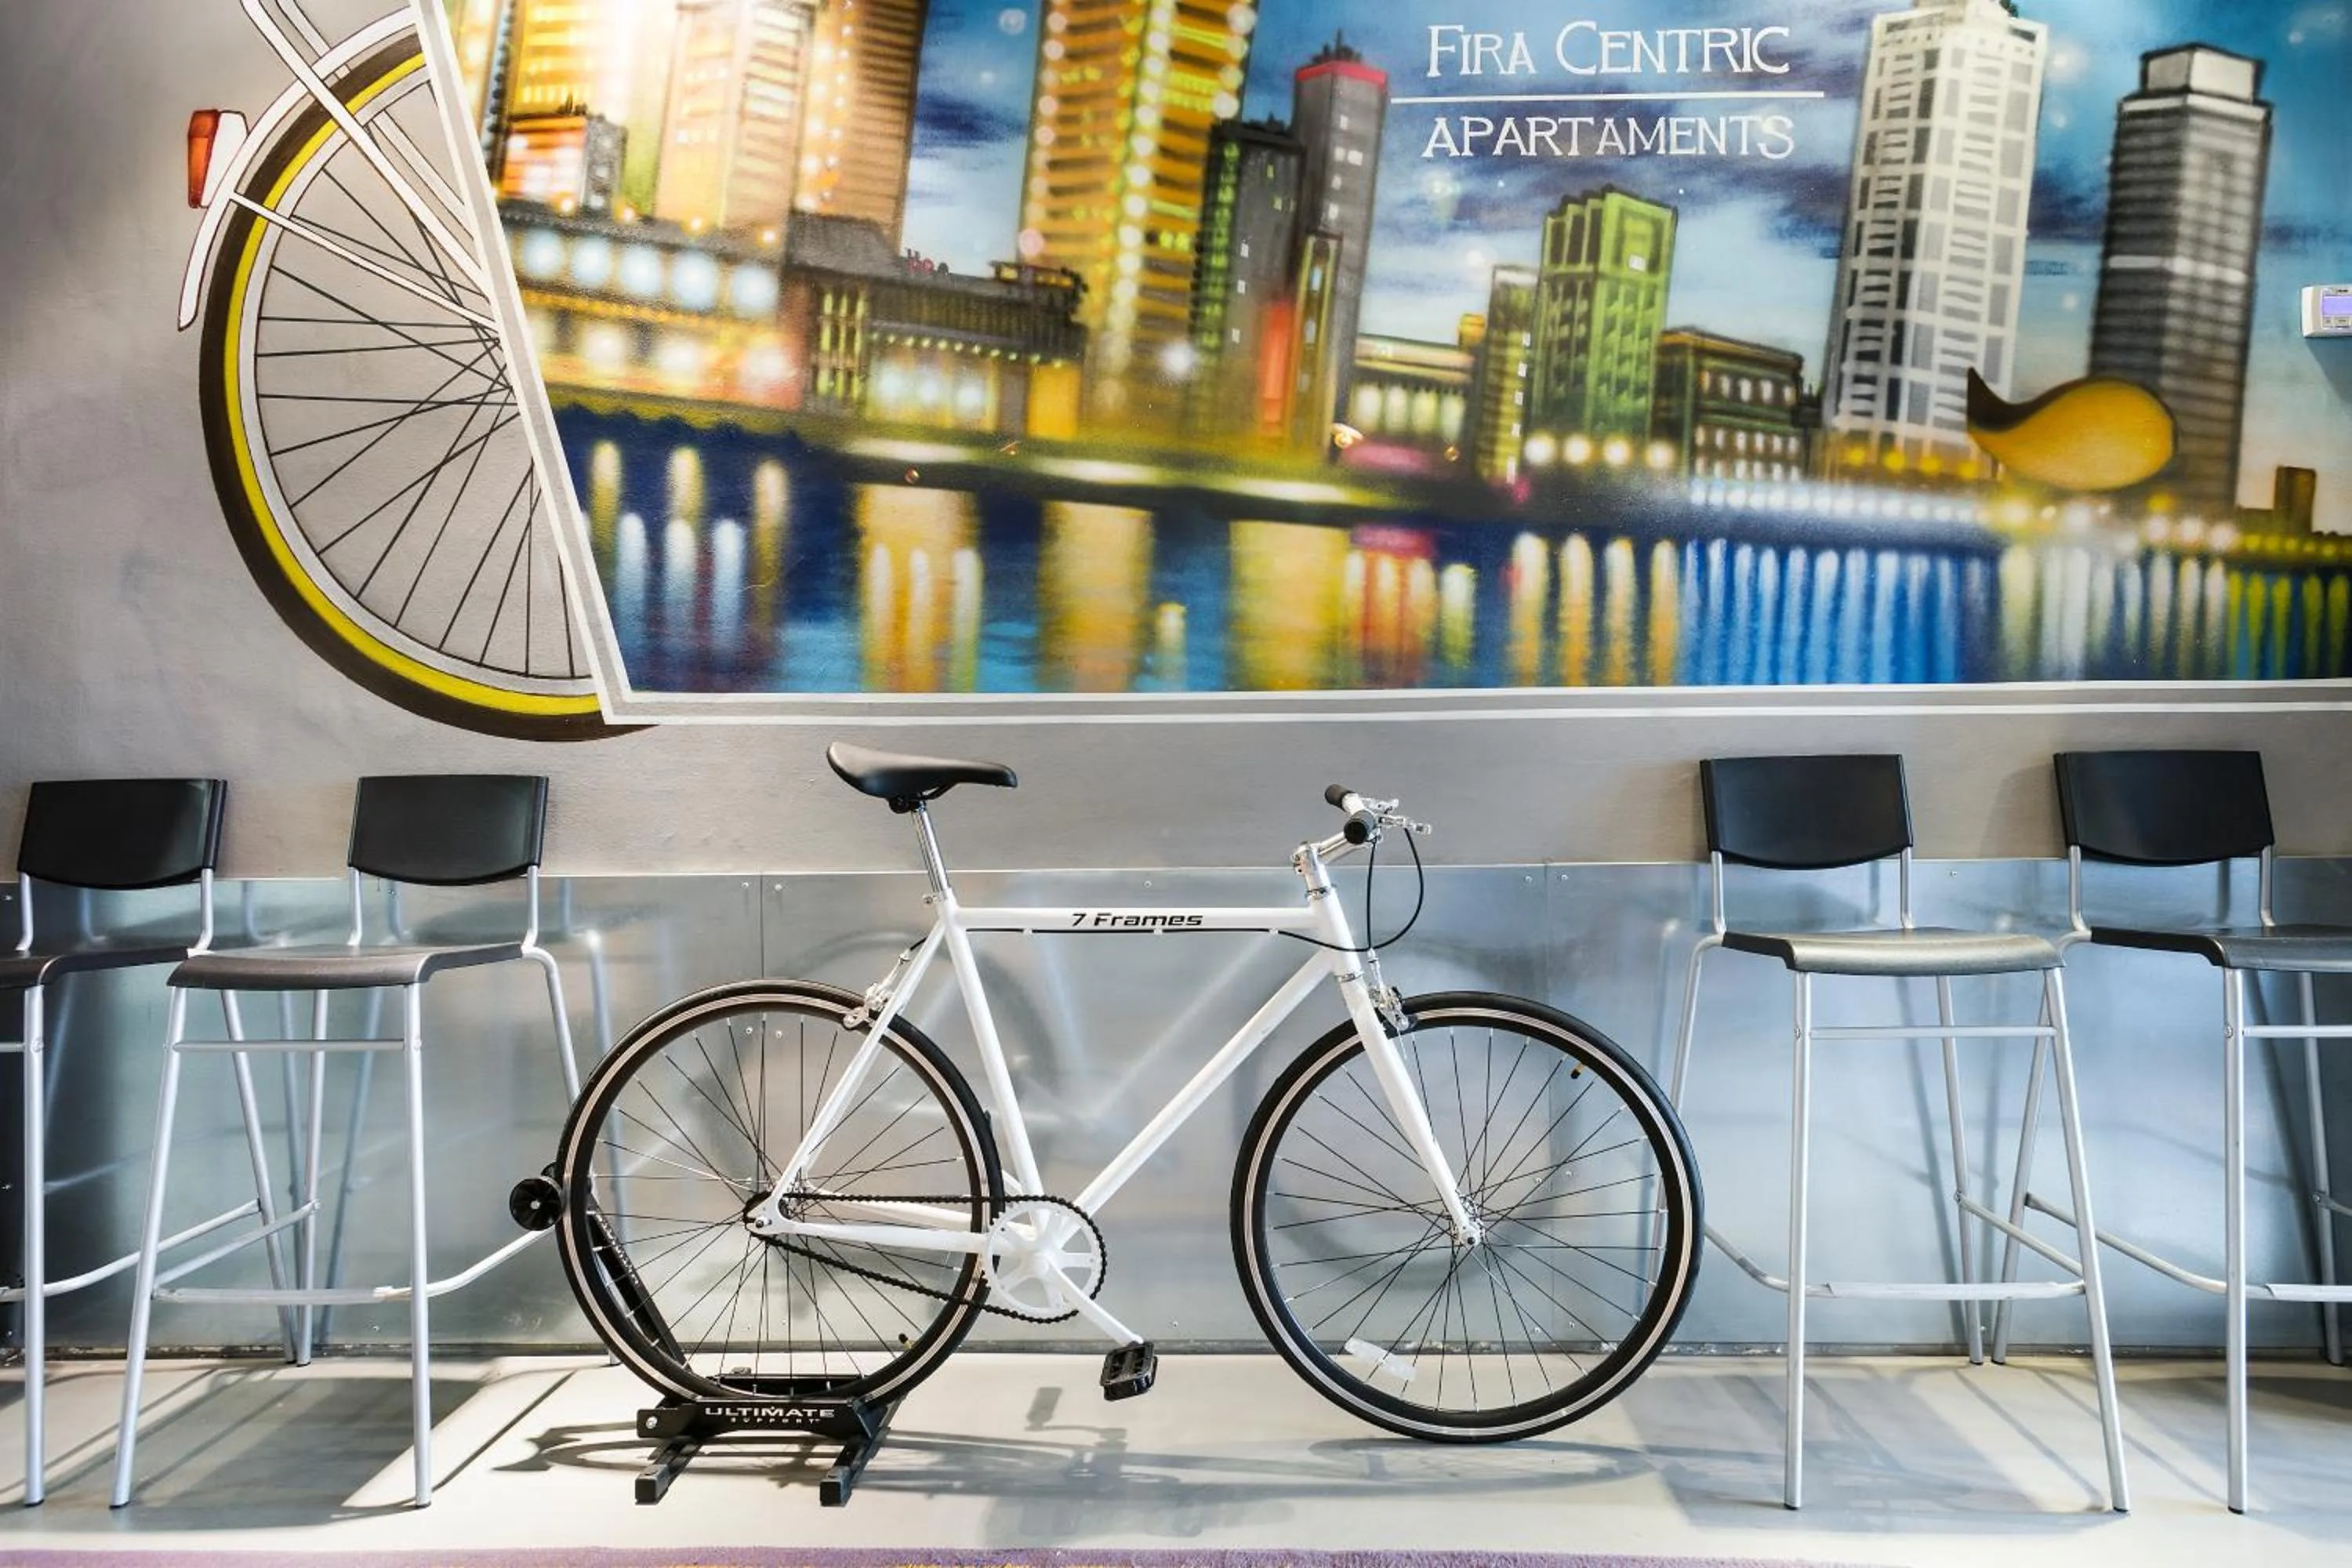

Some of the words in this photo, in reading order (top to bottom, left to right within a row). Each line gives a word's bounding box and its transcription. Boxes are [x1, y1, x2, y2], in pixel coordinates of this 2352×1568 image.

[1426, 24, 1537, 78] FIRA
[1555, 20, 1791, 76] CENTRIC
[1421, 115, 1795, 160] APARTAMENTS
[1072, 913, 1087, 927] 7
[1094, 912, 1204, 927] Frames
[705, 1406, 835, 1418] ULTIMATE
